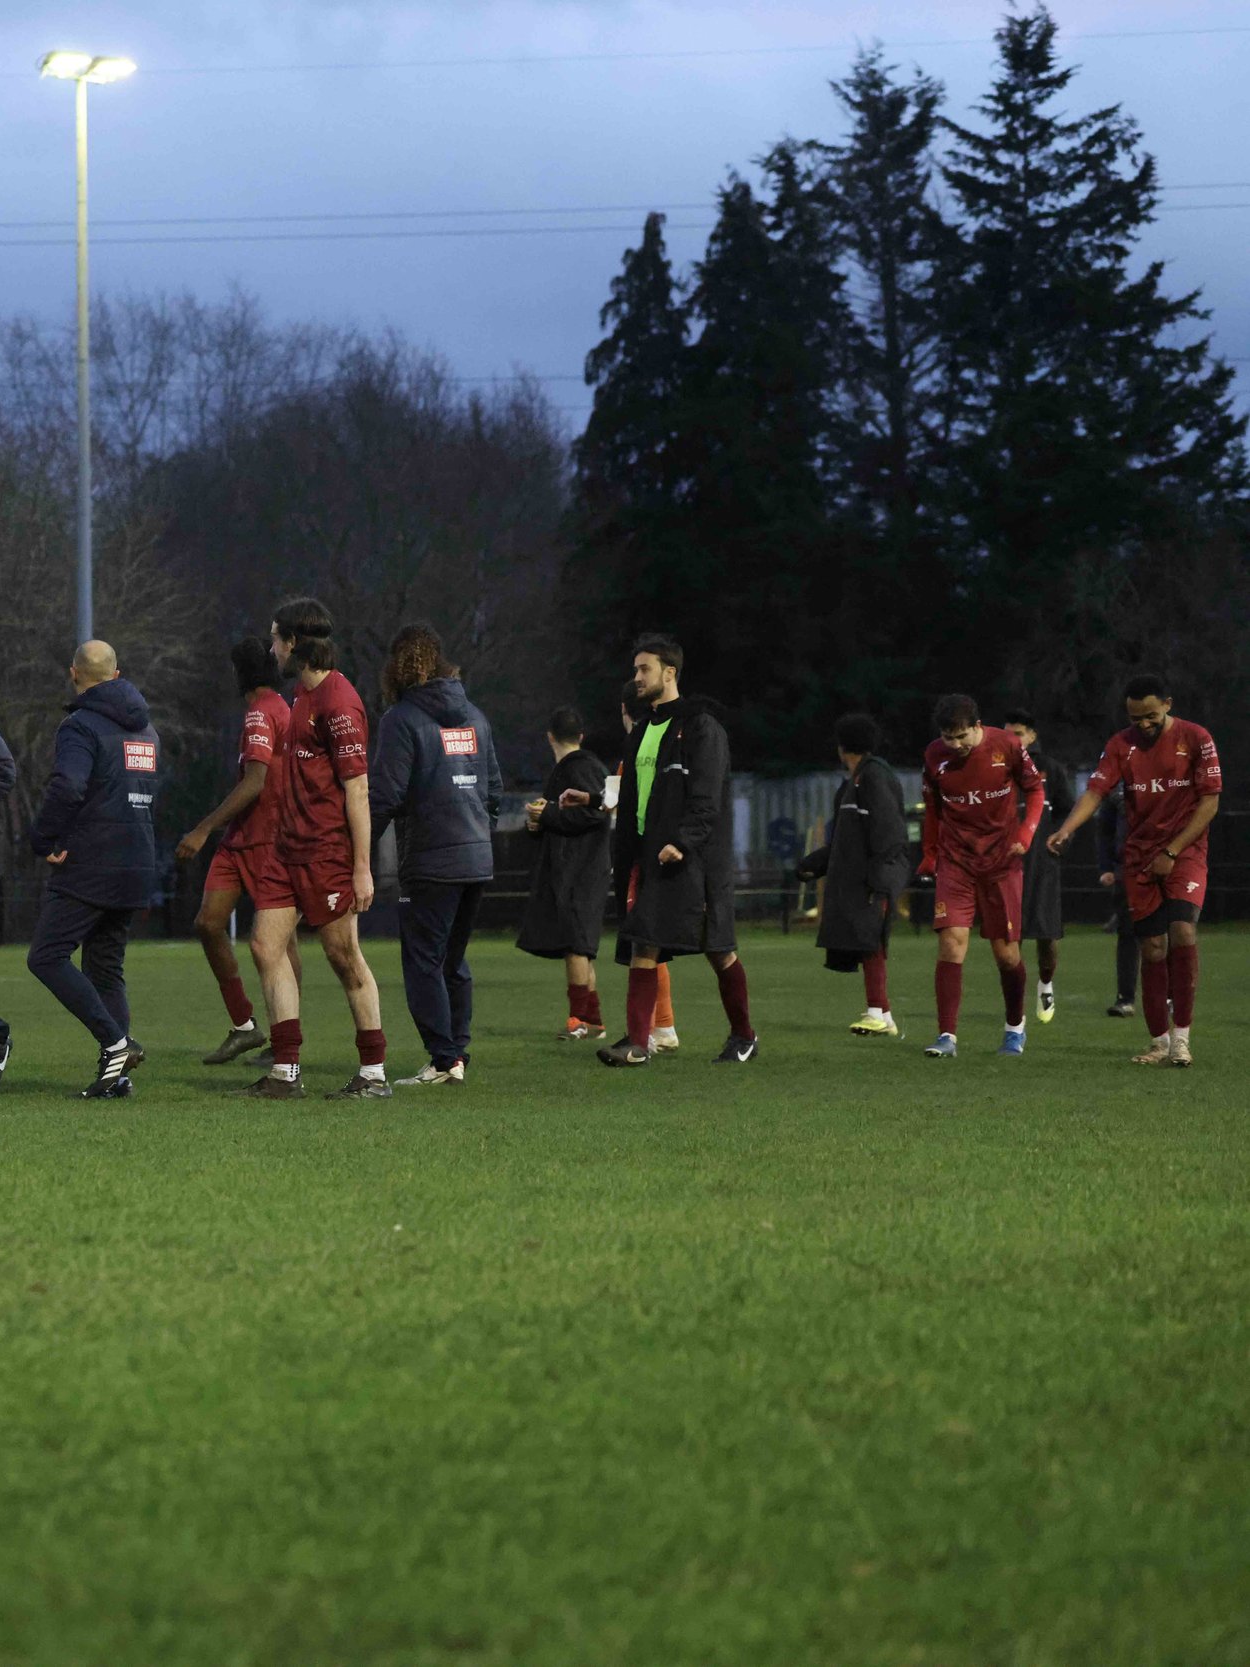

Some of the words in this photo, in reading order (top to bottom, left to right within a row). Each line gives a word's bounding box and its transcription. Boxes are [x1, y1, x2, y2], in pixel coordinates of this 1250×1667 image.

[248, 733, 269, 744] EDR
[338, 743, 362, 755] EDR
[1151, 778, 1165, 793] K
[967, 790, 982, 805] K
